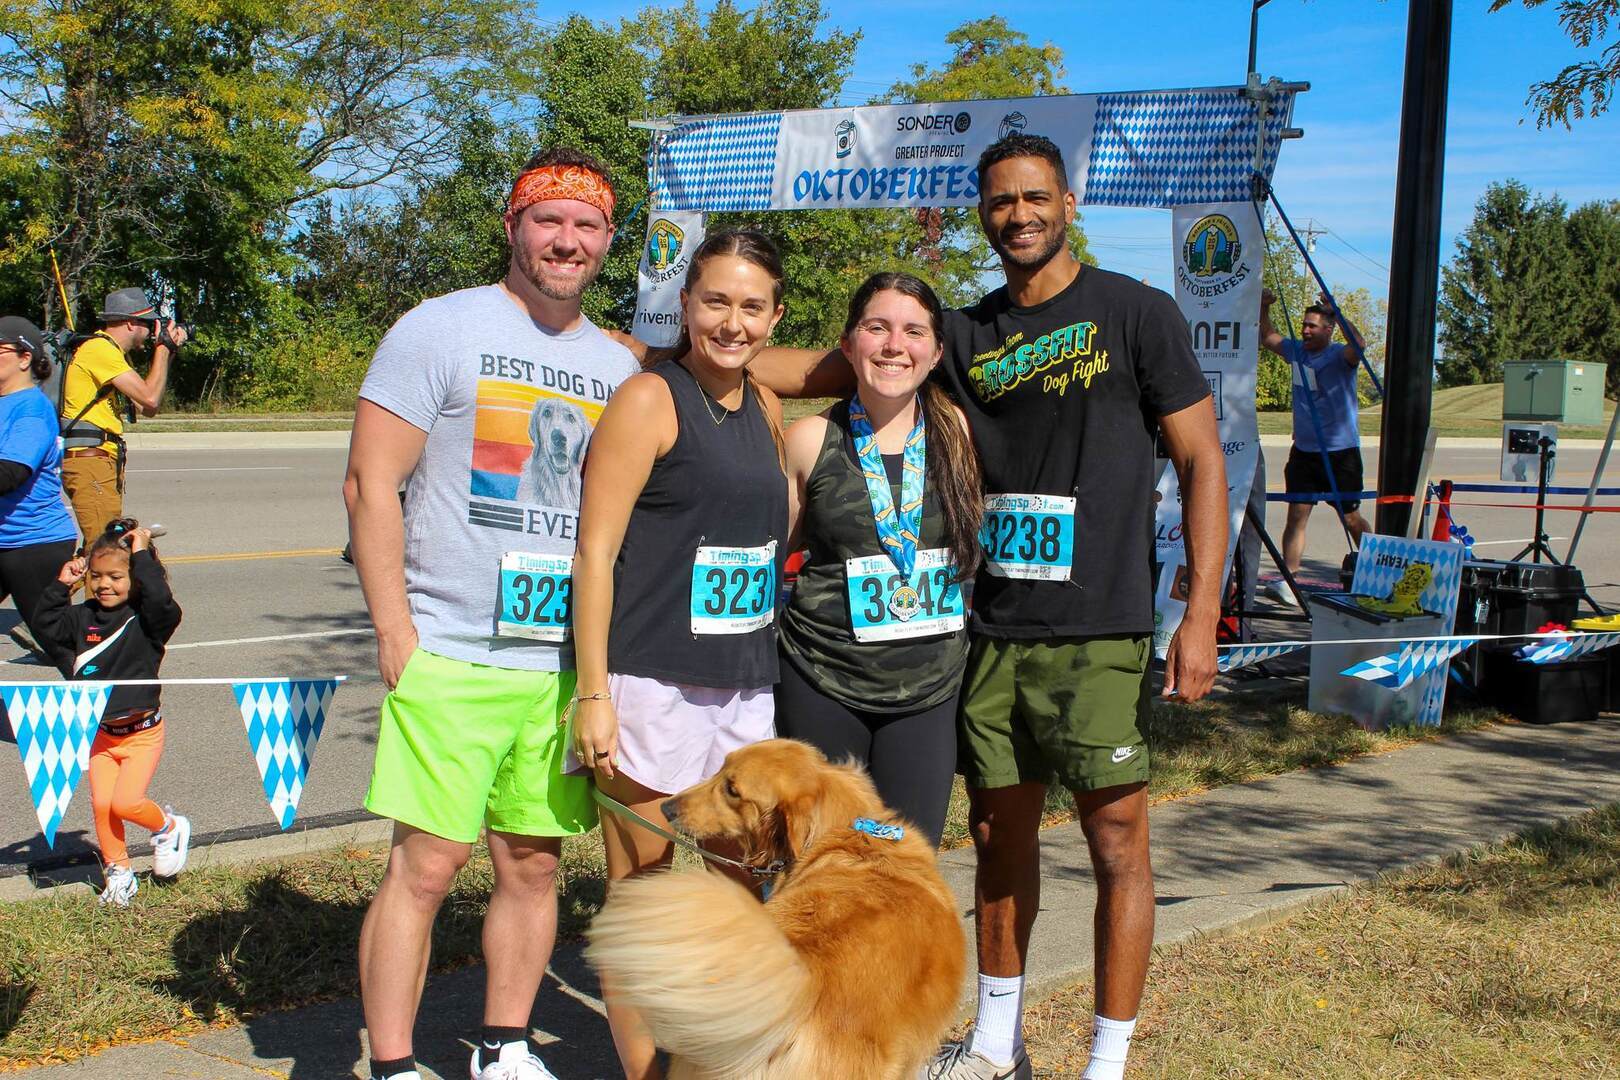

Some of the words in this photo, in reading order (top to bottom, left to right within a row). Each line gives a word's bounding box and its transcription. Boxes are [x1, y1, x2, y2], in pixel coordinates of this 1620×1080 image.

[896, 115, 955, 136] SONDER
[895, 146, 928, 160] GREATER
[930, 144, 966, 158] PROJECT
[793, 165, 979, 202] OKTOBERFES
[1178, 262, 1251, 298] OKTOBERFEST
[638, 309, 679, 325] rivent
[1189, 320, 1241, 350] NFI
[968, 321, 1097, 403] CROSSFIT
[1043, 372, 1069, 396] Dog
[1072, 349, 1110, 388] Fight
[480, 354, 535, 382] BEST
[541, 365, 586, 396] DOG
[591, 378, 617, 402] DA
[527, 509, 580, 541] EVE
[984, 514, 1061, 562] 3238
[518, 556, 568, 573] TimingSp
[710, 550, 762, 565] TimingSp
[1375, 553, 1408, 569] YEAH!
[512, 573, 573, 624] 323
[1115, 746, 1133, 757] NIKE
